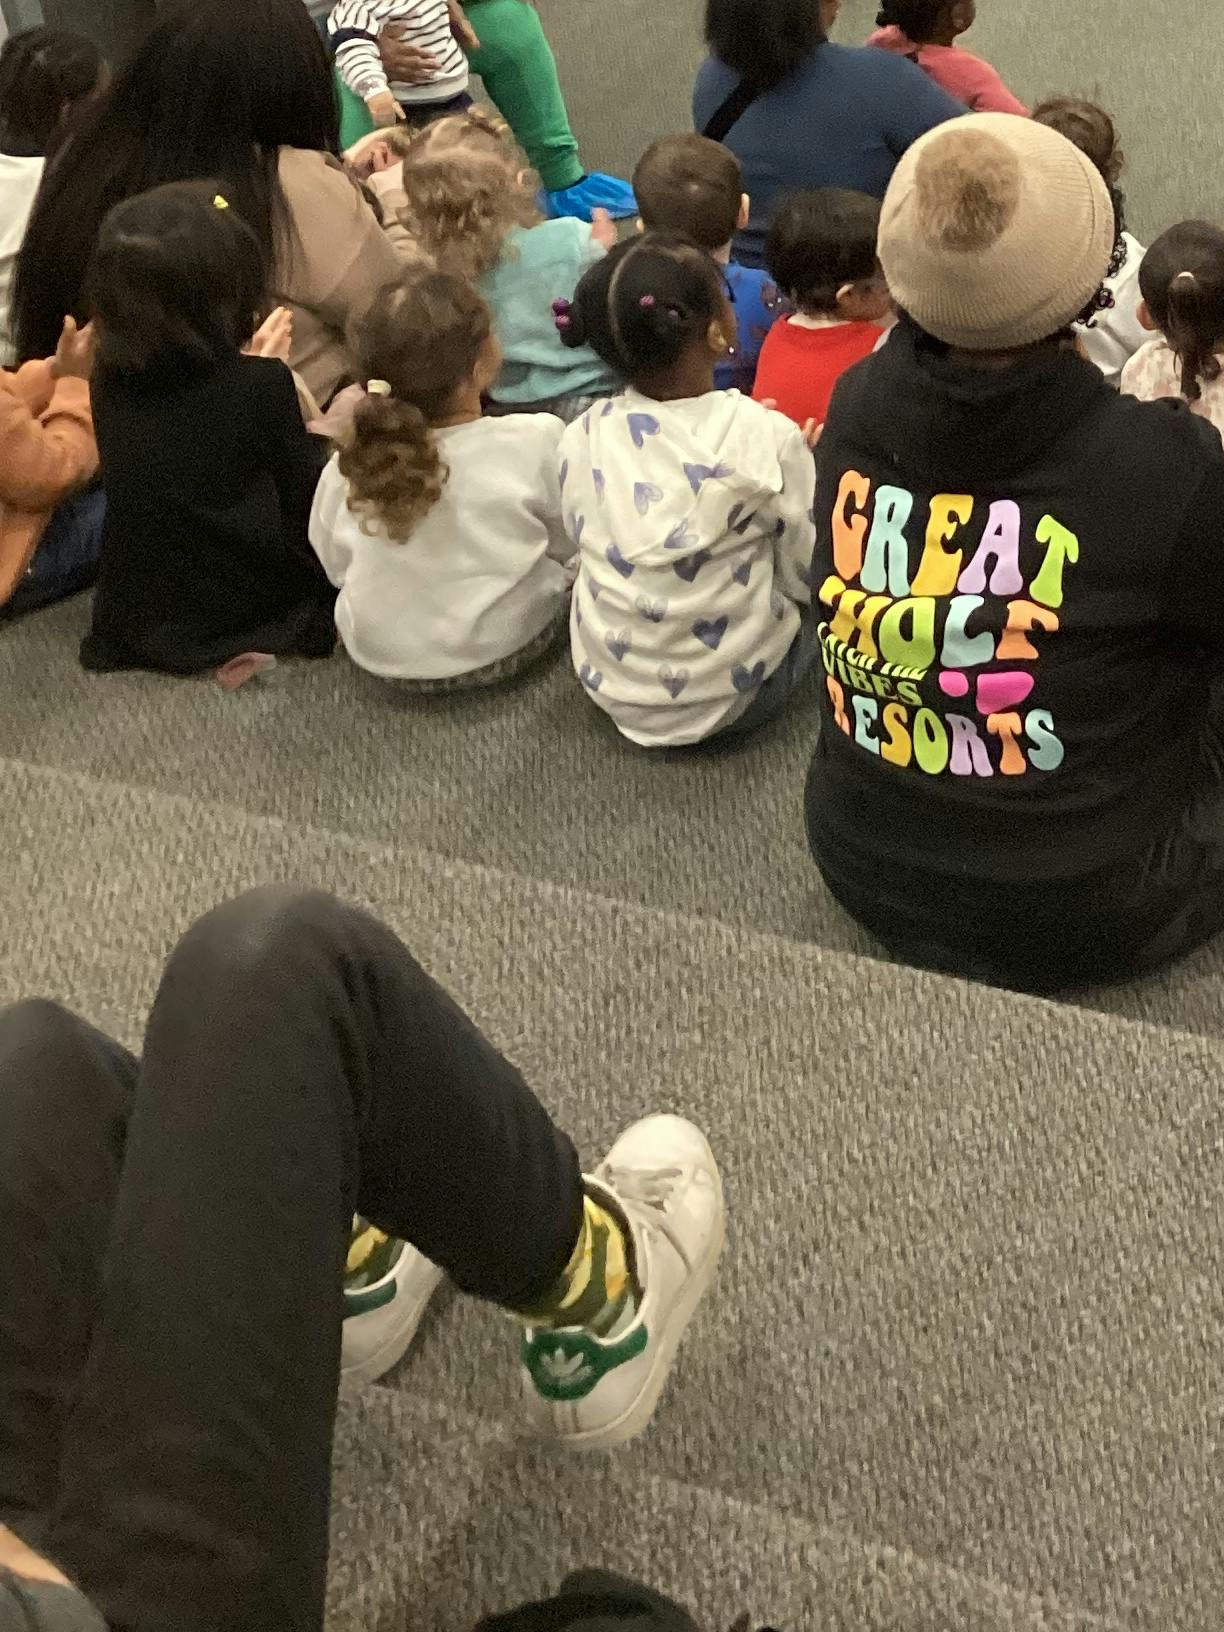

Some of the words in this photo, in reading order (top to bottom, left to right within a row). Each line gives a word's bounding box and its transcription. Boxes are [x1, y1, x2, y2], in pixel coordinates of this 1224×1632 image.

[832, 470, 1079, 608] GREAT
[819, 575, 1059, 670] WOLF
[820, 644, 923, 706] VIBES
[827, 675, 1064, 777] RESORTS
